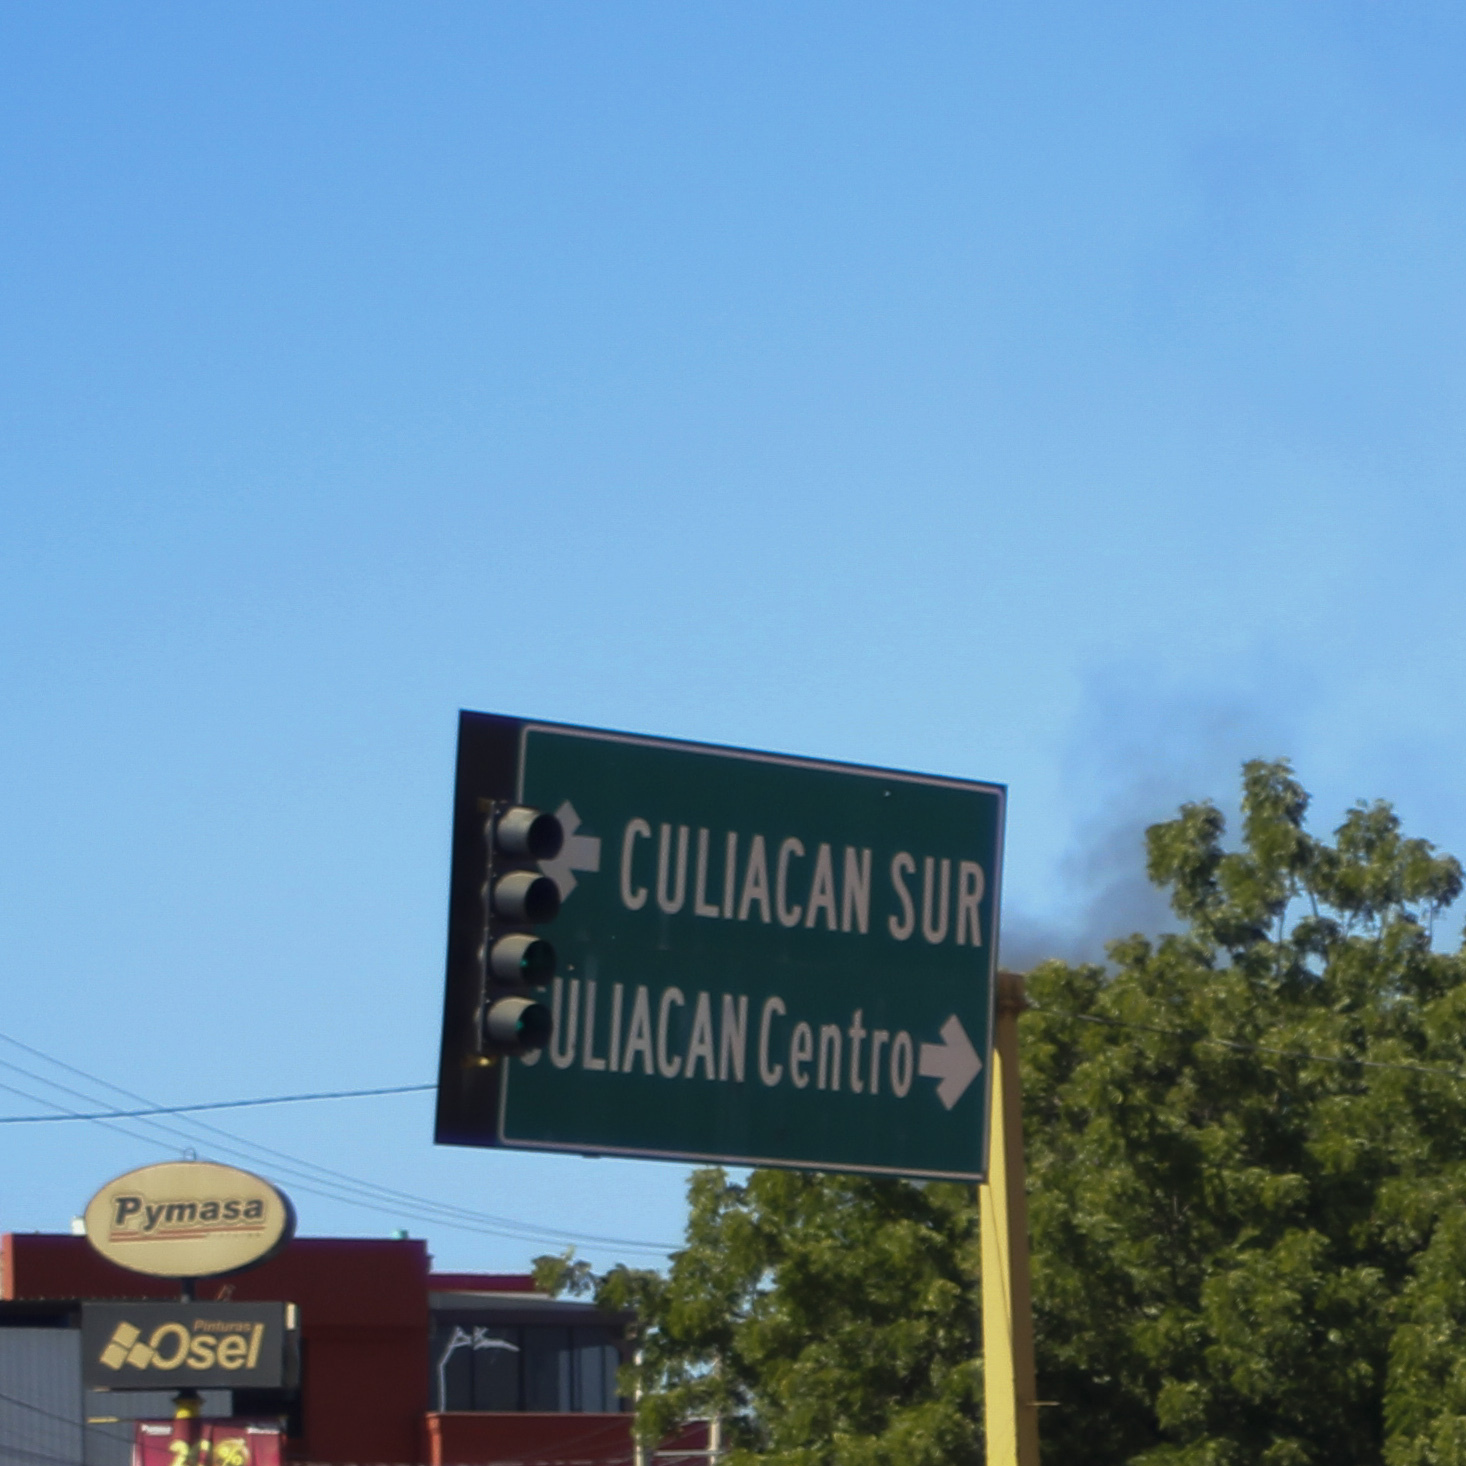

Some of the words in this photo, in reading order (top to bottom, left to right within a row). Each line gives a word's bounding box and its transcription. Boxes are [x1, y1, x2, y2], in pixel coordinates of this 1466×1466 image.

[620, 817, 872, 936] CULIACAN
[888, 851, 986, 948] SUR
[521, 974, 750, 1084] ULIACAN
[758, 996, 914, 1099] Centro
[115, 1197, 263, 1231] Pymasa
[150, 1322, 264, 1370] Osel
[194, 1319, 251, 1332] Pinturas
